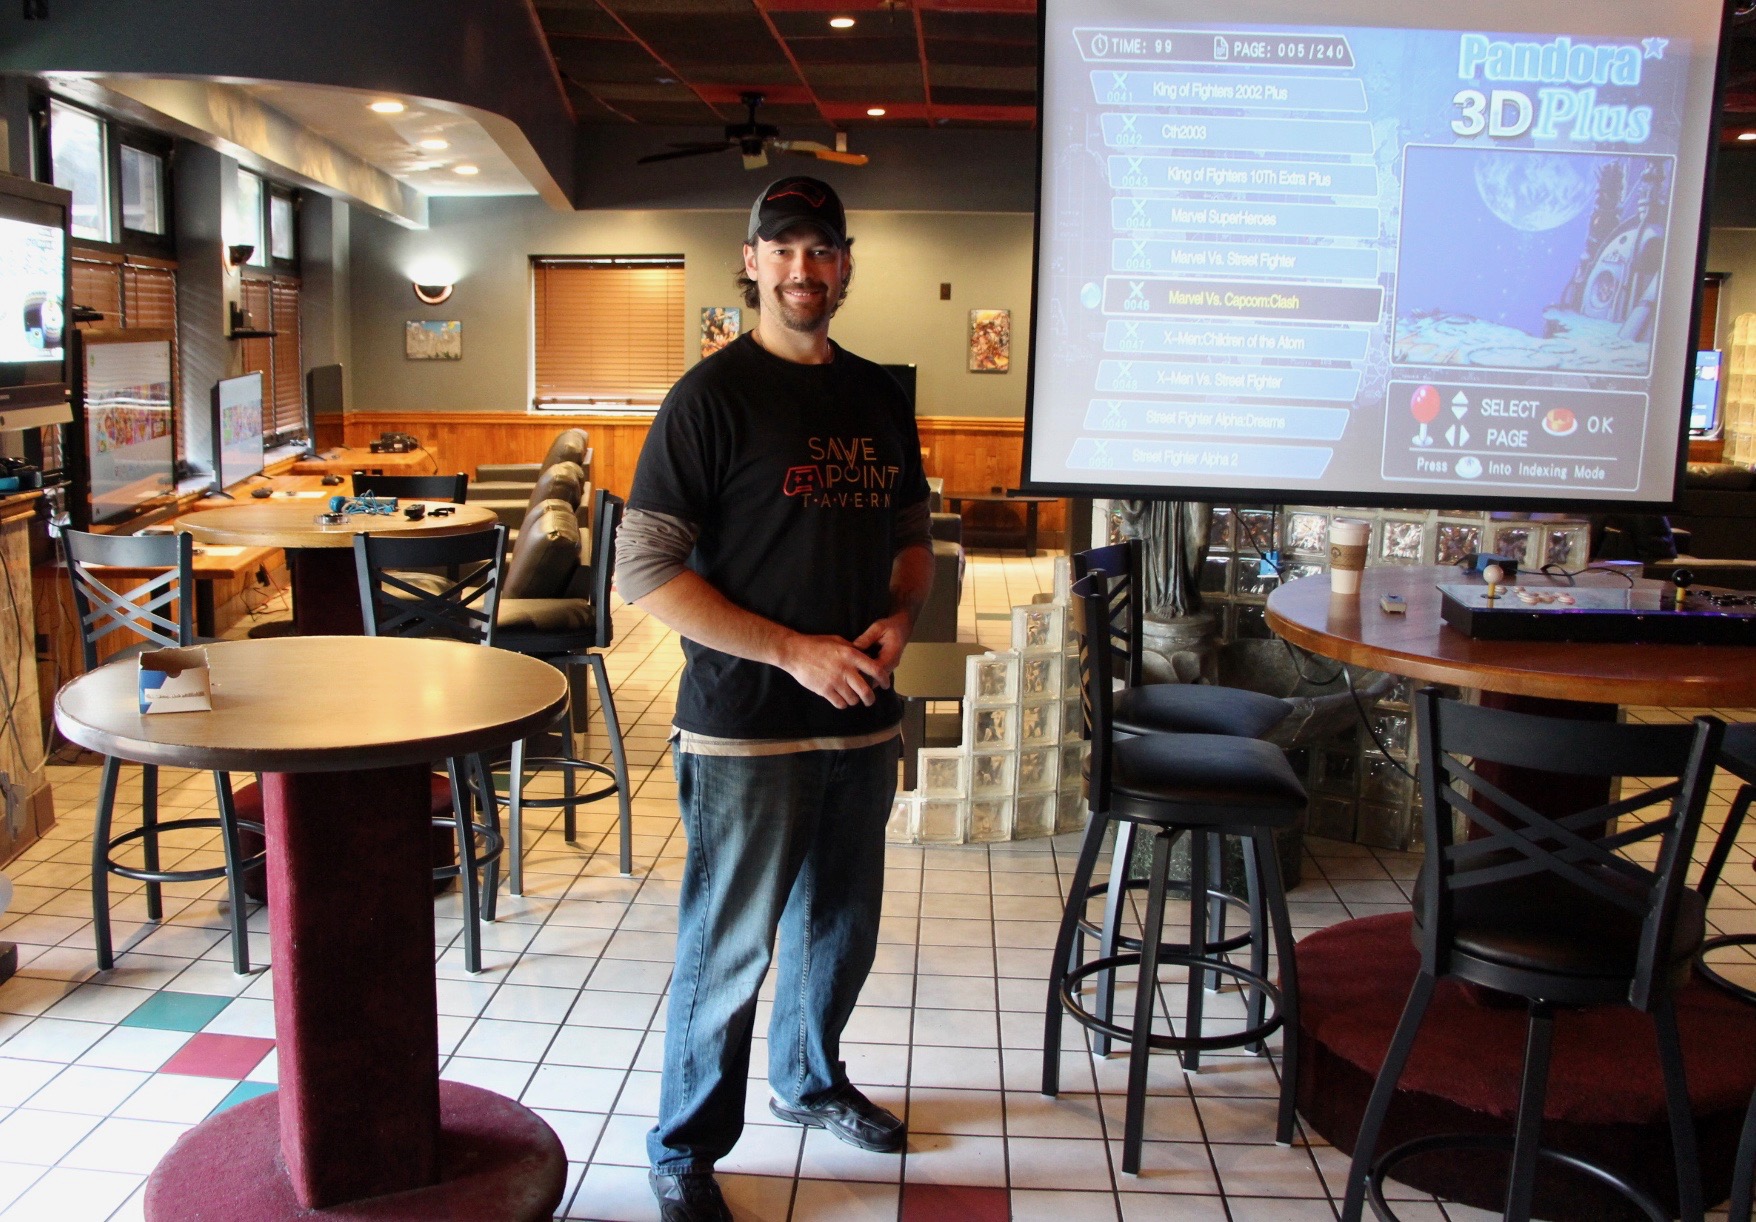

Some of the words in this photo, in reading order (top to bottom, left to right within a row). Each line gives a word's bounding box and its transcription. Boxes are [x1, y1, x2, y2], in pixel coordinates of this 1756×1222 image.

[1112, 37, 1147, 54] TIME:
[1154, 39, 1173, 54] 99
[1233, 41, 1271, 59] PAGE:
[1277, 44, 1345, 60] 005/240
[1458, 33, 1642, 86] Pandora
[1153, 82, 1177, 100] King
[1179, 83, 1191, 97] of
[1192, 83, 1233, 101] Fighters
[1235, 84, 1262, 100] 2002
[1264, 85, 1288, 101] Plus
[1450, 88, 1534, 137] 3D
[1531, 87, 1653, 144] Plus
[1167, 166, 1192, 184] King
[1193, 167, 1205, 182] of
[1206, 167, 1248, 185] Fighters
[1251, 169, 1276, 184] 10Th
[1278, 170, 1306, 186] Extra
[1307, 171, 1331, 187] Plus
[1171, 208, 1207, 223] Marvel
[1209, 209, 1277, 228] SuperHeroes
[1170, 249, 1206, 265] Marvel
[1208, 251, 1224, 265] Vs.
[1227, 252, 1258, 267] Street
[1259, 253, 1296, 271] Fighter
[1169, 290, 1204, 306] Marvel
[1206, 292, 1222, 306] Vs.
[1247, 334, 1259, 348] of
[1259, 334, 1275, 349] the
[1276, 335, 1305, 350] Atom
[1157, 371, 1193, 386] X-Men
[1215, 372, 1246, 387] Street
[1247, 373, 1283, 392] Fighter
[1480, 398, 1540, 419] SELECT
[1146, 410, 1177, 425] Street
[1178, 411, 1214, 429] Fighter
[1587, 415, 1614, 434] OK
[1486, 428, 1529, 448] PAGE
[808, 437, 877, 470] SAVE
[1132, 449, 1162, 463] Street
[1164, 450, 1199, 467] Fighter
[1200, 451, 1230, 468] Alpha
[1230, 453, 1239, 466] 2
[826, 464, 899, 489] POINT
[1417, 457, 1448, 473] Press
[1488, 460, 1512, 475] Into
[1518, 461, 1567, 480] Indexing
[1574, 465, 1605, 480] Mode
